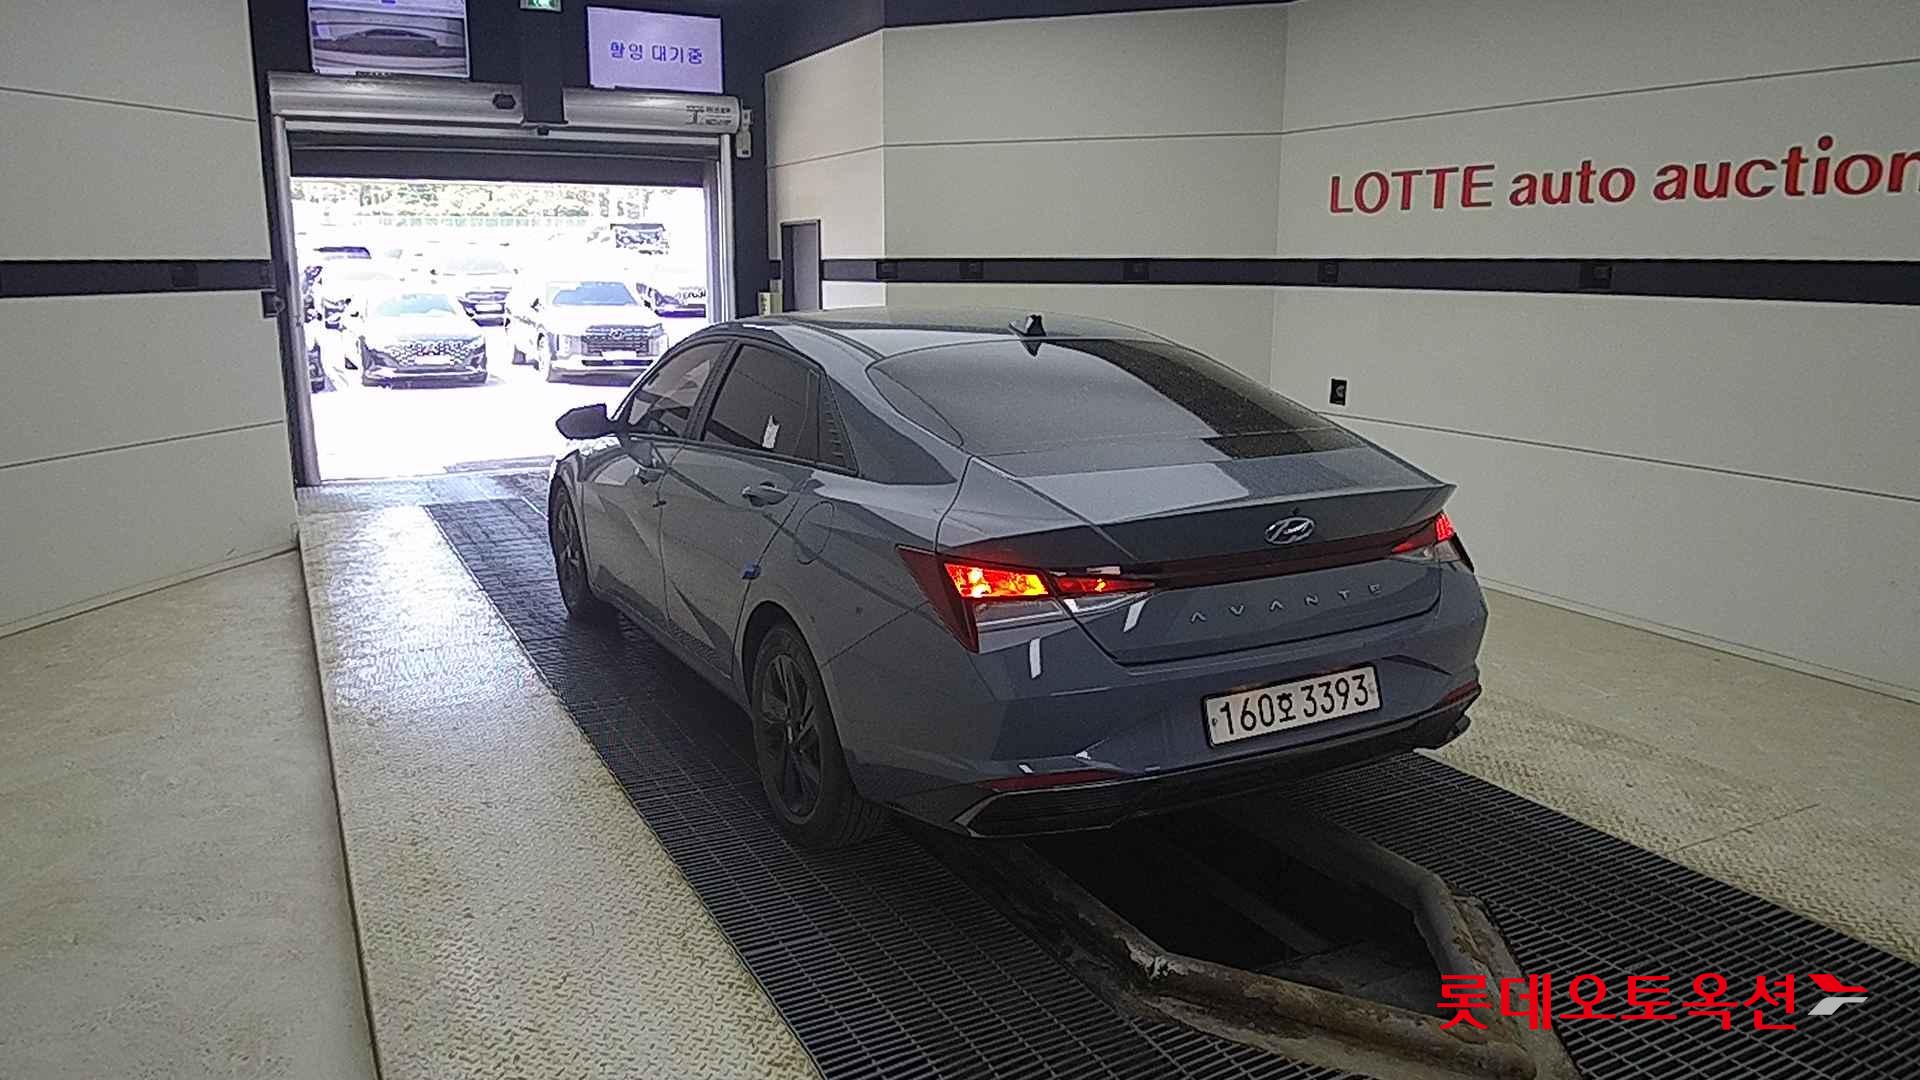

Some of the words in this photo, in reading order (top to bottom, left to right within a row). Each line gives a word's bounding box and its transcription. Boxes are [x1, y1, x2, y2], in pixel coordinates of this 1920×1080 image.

[651, 44, 703, 65] 대기중
[1329, 164, 1496, 214] LOTTE
[1509, 160, 1637, 207] auto
[1190, 583, 1382, 624] AVANTE
